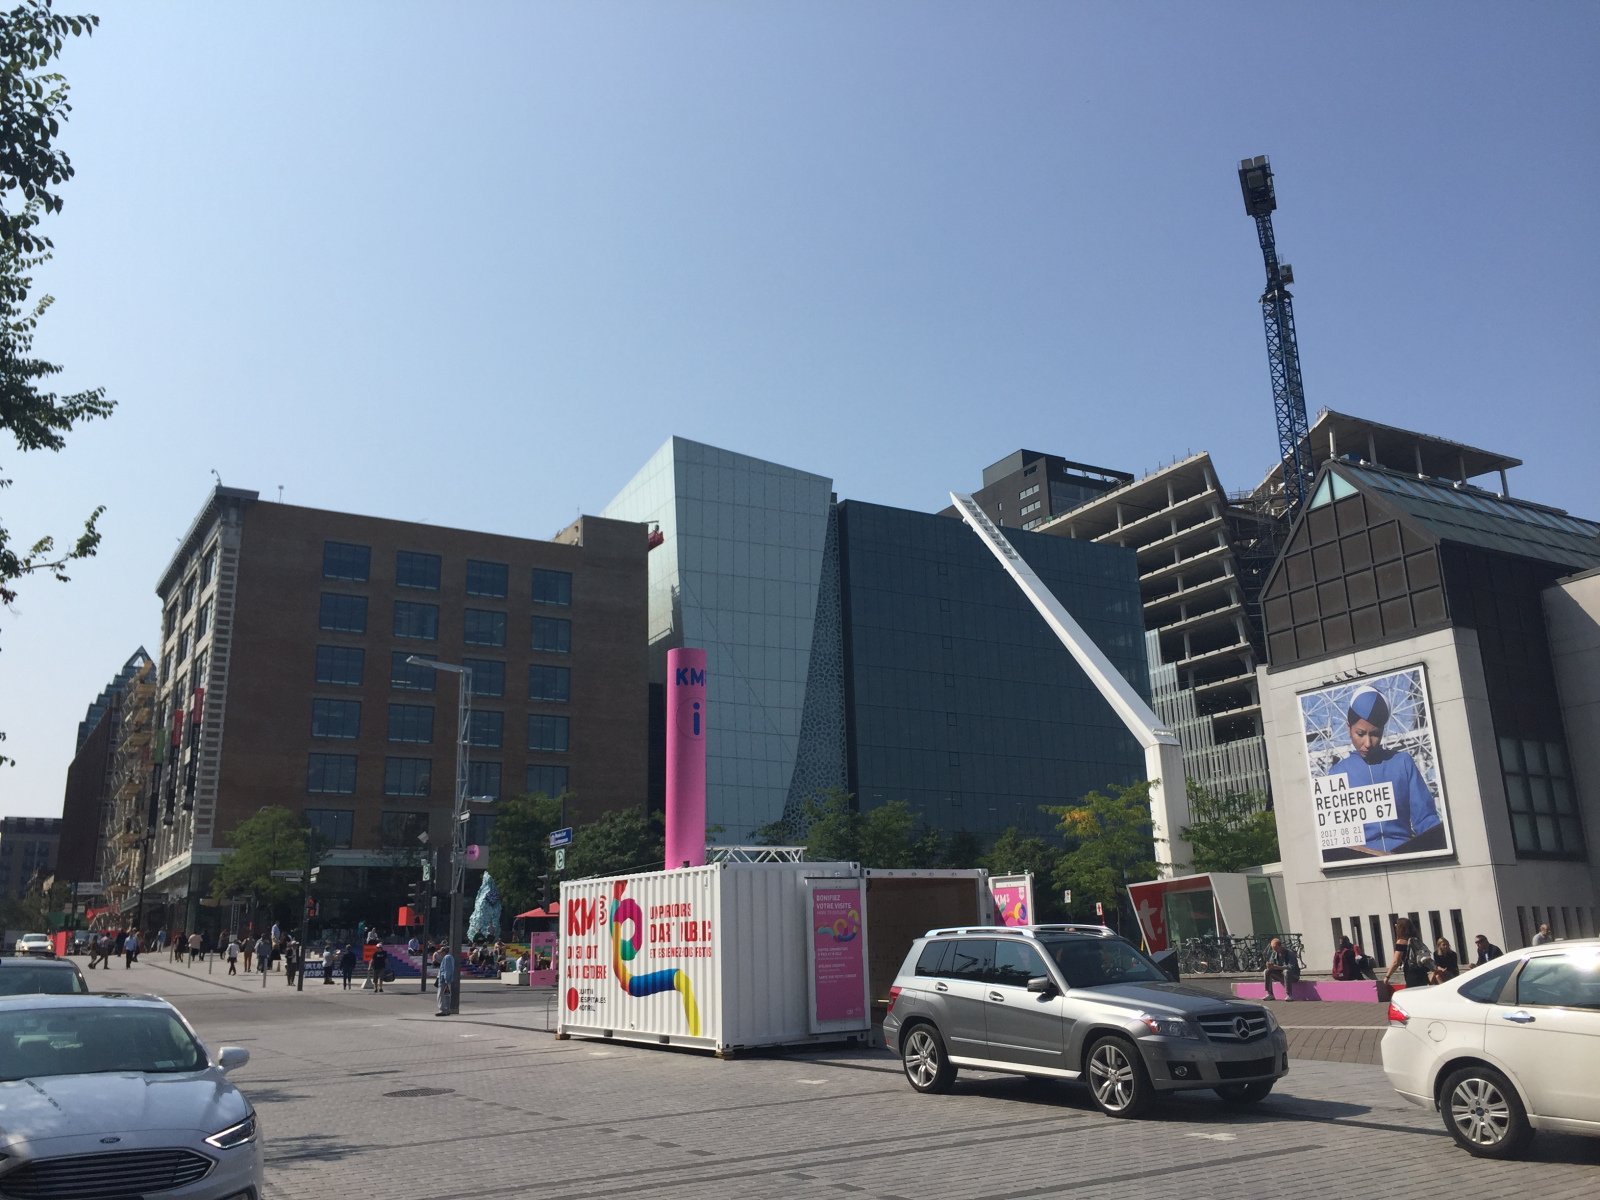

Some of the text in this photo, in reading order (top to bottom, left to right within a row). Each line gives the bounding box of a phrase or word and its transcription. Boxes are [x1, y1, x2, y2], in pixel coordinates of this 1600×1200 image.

[676, 668, 706, 687] KM
[1314, 778, 1346, 795] À LA
[1316, 787, 1390, 811] RECHERCHE
[1318, 803, 1391, 826] D'EXPO 67
[1321, 829, 1336, 838] 2017
[1353, 826, 1361, 834] 21
[1322, 838, 1338, 847] 2017
[1355, 835, 1363, 843] 01
